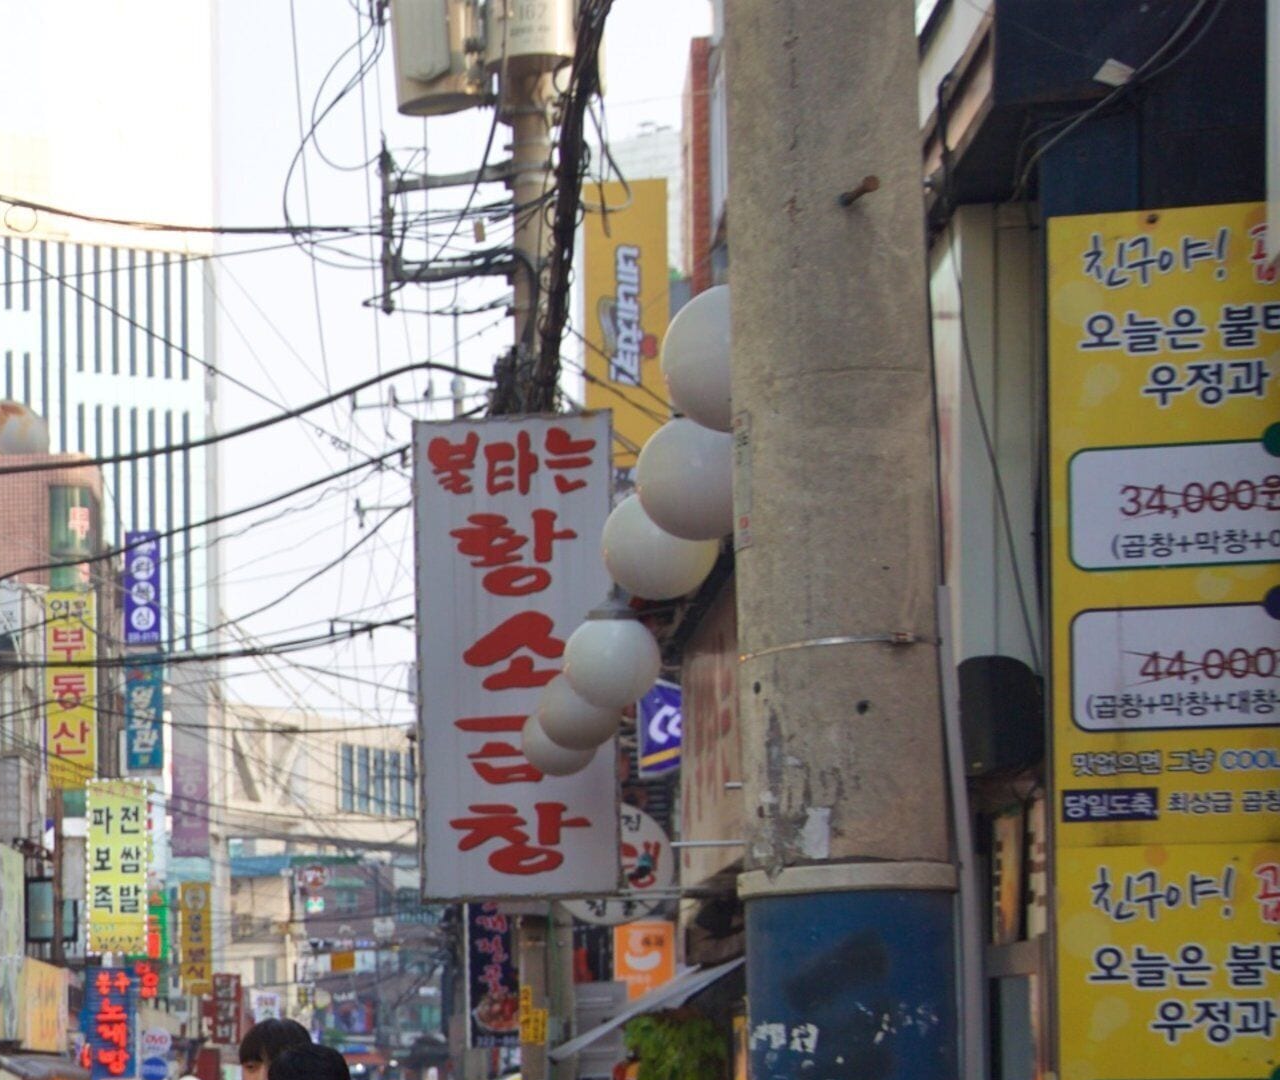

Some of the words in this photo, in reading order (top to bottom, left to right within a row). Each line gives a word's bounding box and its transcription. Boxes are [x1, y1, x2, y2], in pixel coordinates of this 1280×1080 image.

[1083, 228, 1228, 287] 친구야!
[1080, 307, 1205, 353] 오늘은
[1143, 360, 1270, 406] 우정과
[426, 429, 598, 497] 불타는
[51, 626, 90, 757] 부동산
[448, 507, 593, 877] 황소곱창
[92, 806, 140, 835] 파전
[93, 846, 141, 874] 보쌈
[93, 884, 140, 915] 족발
[1091, 866, 1234, 921] 친구야!
[1088, 944, 1212, 988] 오늘은
[1150, 1001, 1277, 1043] 우정과
